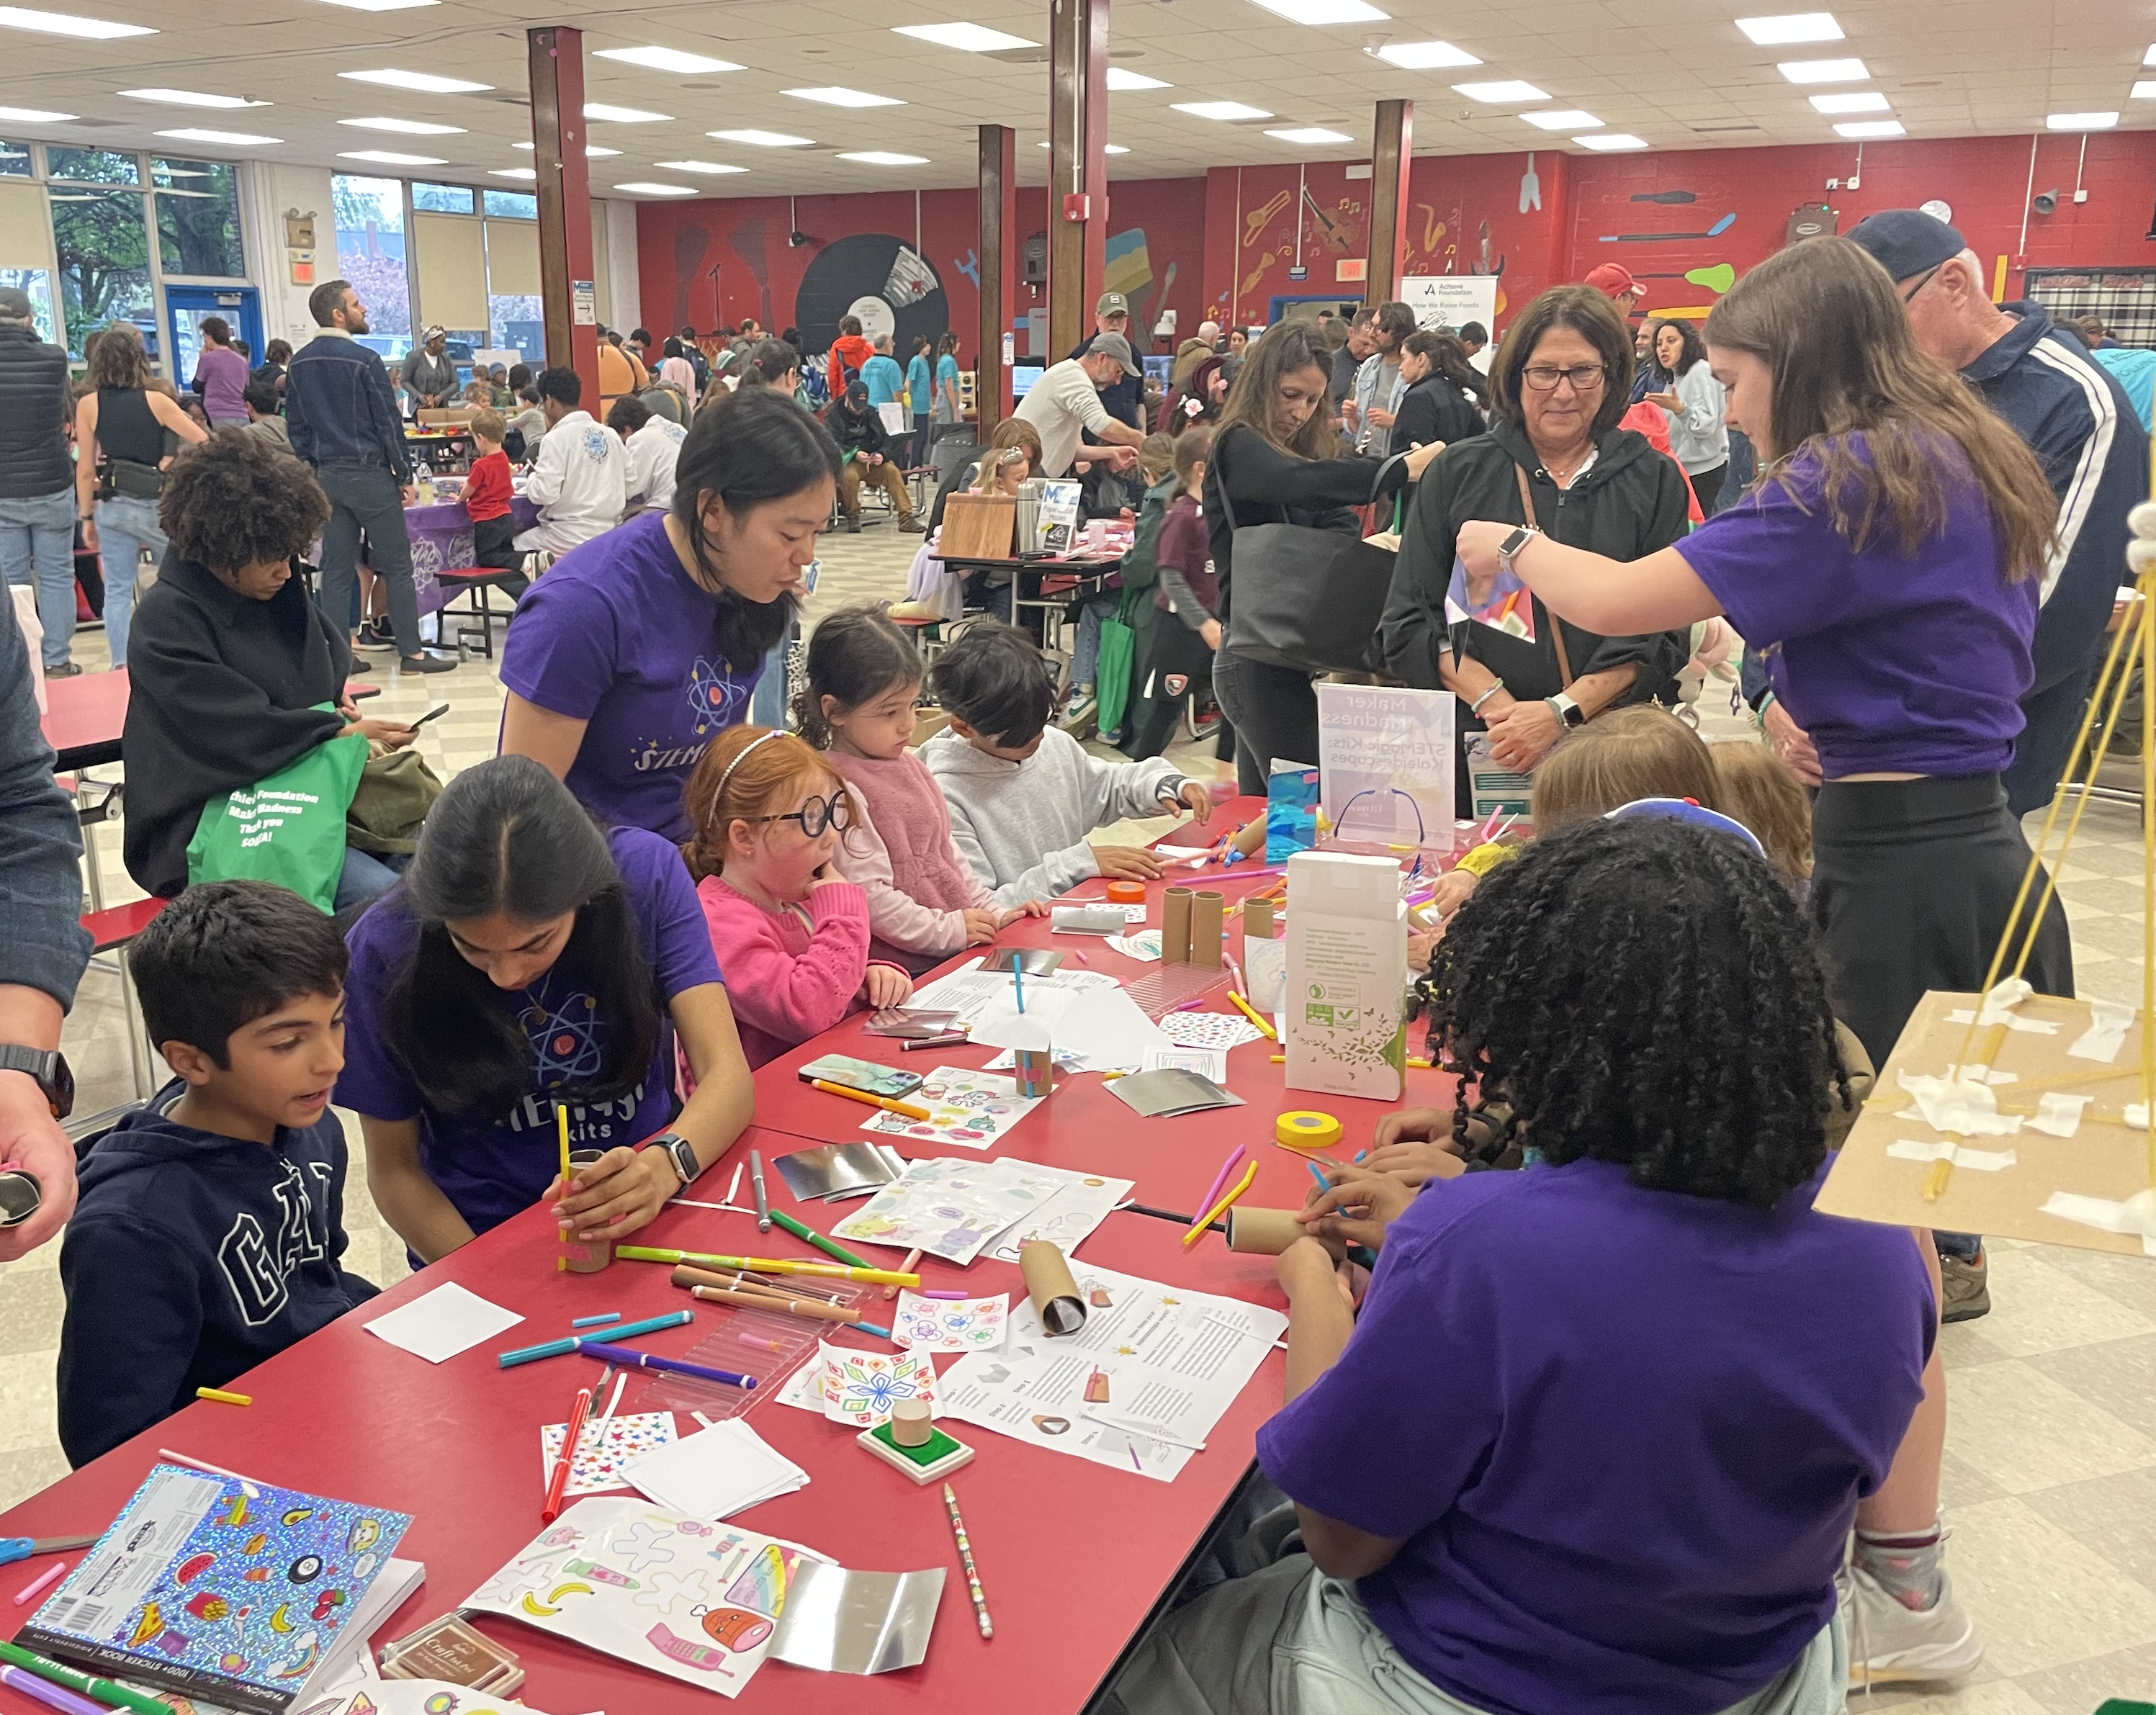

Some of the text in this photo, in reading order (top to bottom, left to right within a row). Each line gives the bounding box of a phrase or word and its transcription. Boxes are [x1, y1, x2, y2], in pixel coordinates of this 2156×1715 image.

[634, 742, 709, 770] STEM
[257, 790, 319, 804] Foundation
[262, 819, 284, 829] you
[1012, 1383, 1025, 1393] Step
[942, 1391, 956, 1403] Step
[989, 1407, 1002, 1417] Step
[1081, 1433, 1095, 1444] Step
[303, 1562, 314, 1571] 8
[99, 1649, 127, 1661] BOOK
[426, 1639, 455, 1659] Craft
[449, 1656, 463, 1666] Ink
[459, 1663, 477, 1674] Pad
[125, 1655, 162, 1670] STICKER
[162, 1665, 190, 1678] 1000+
